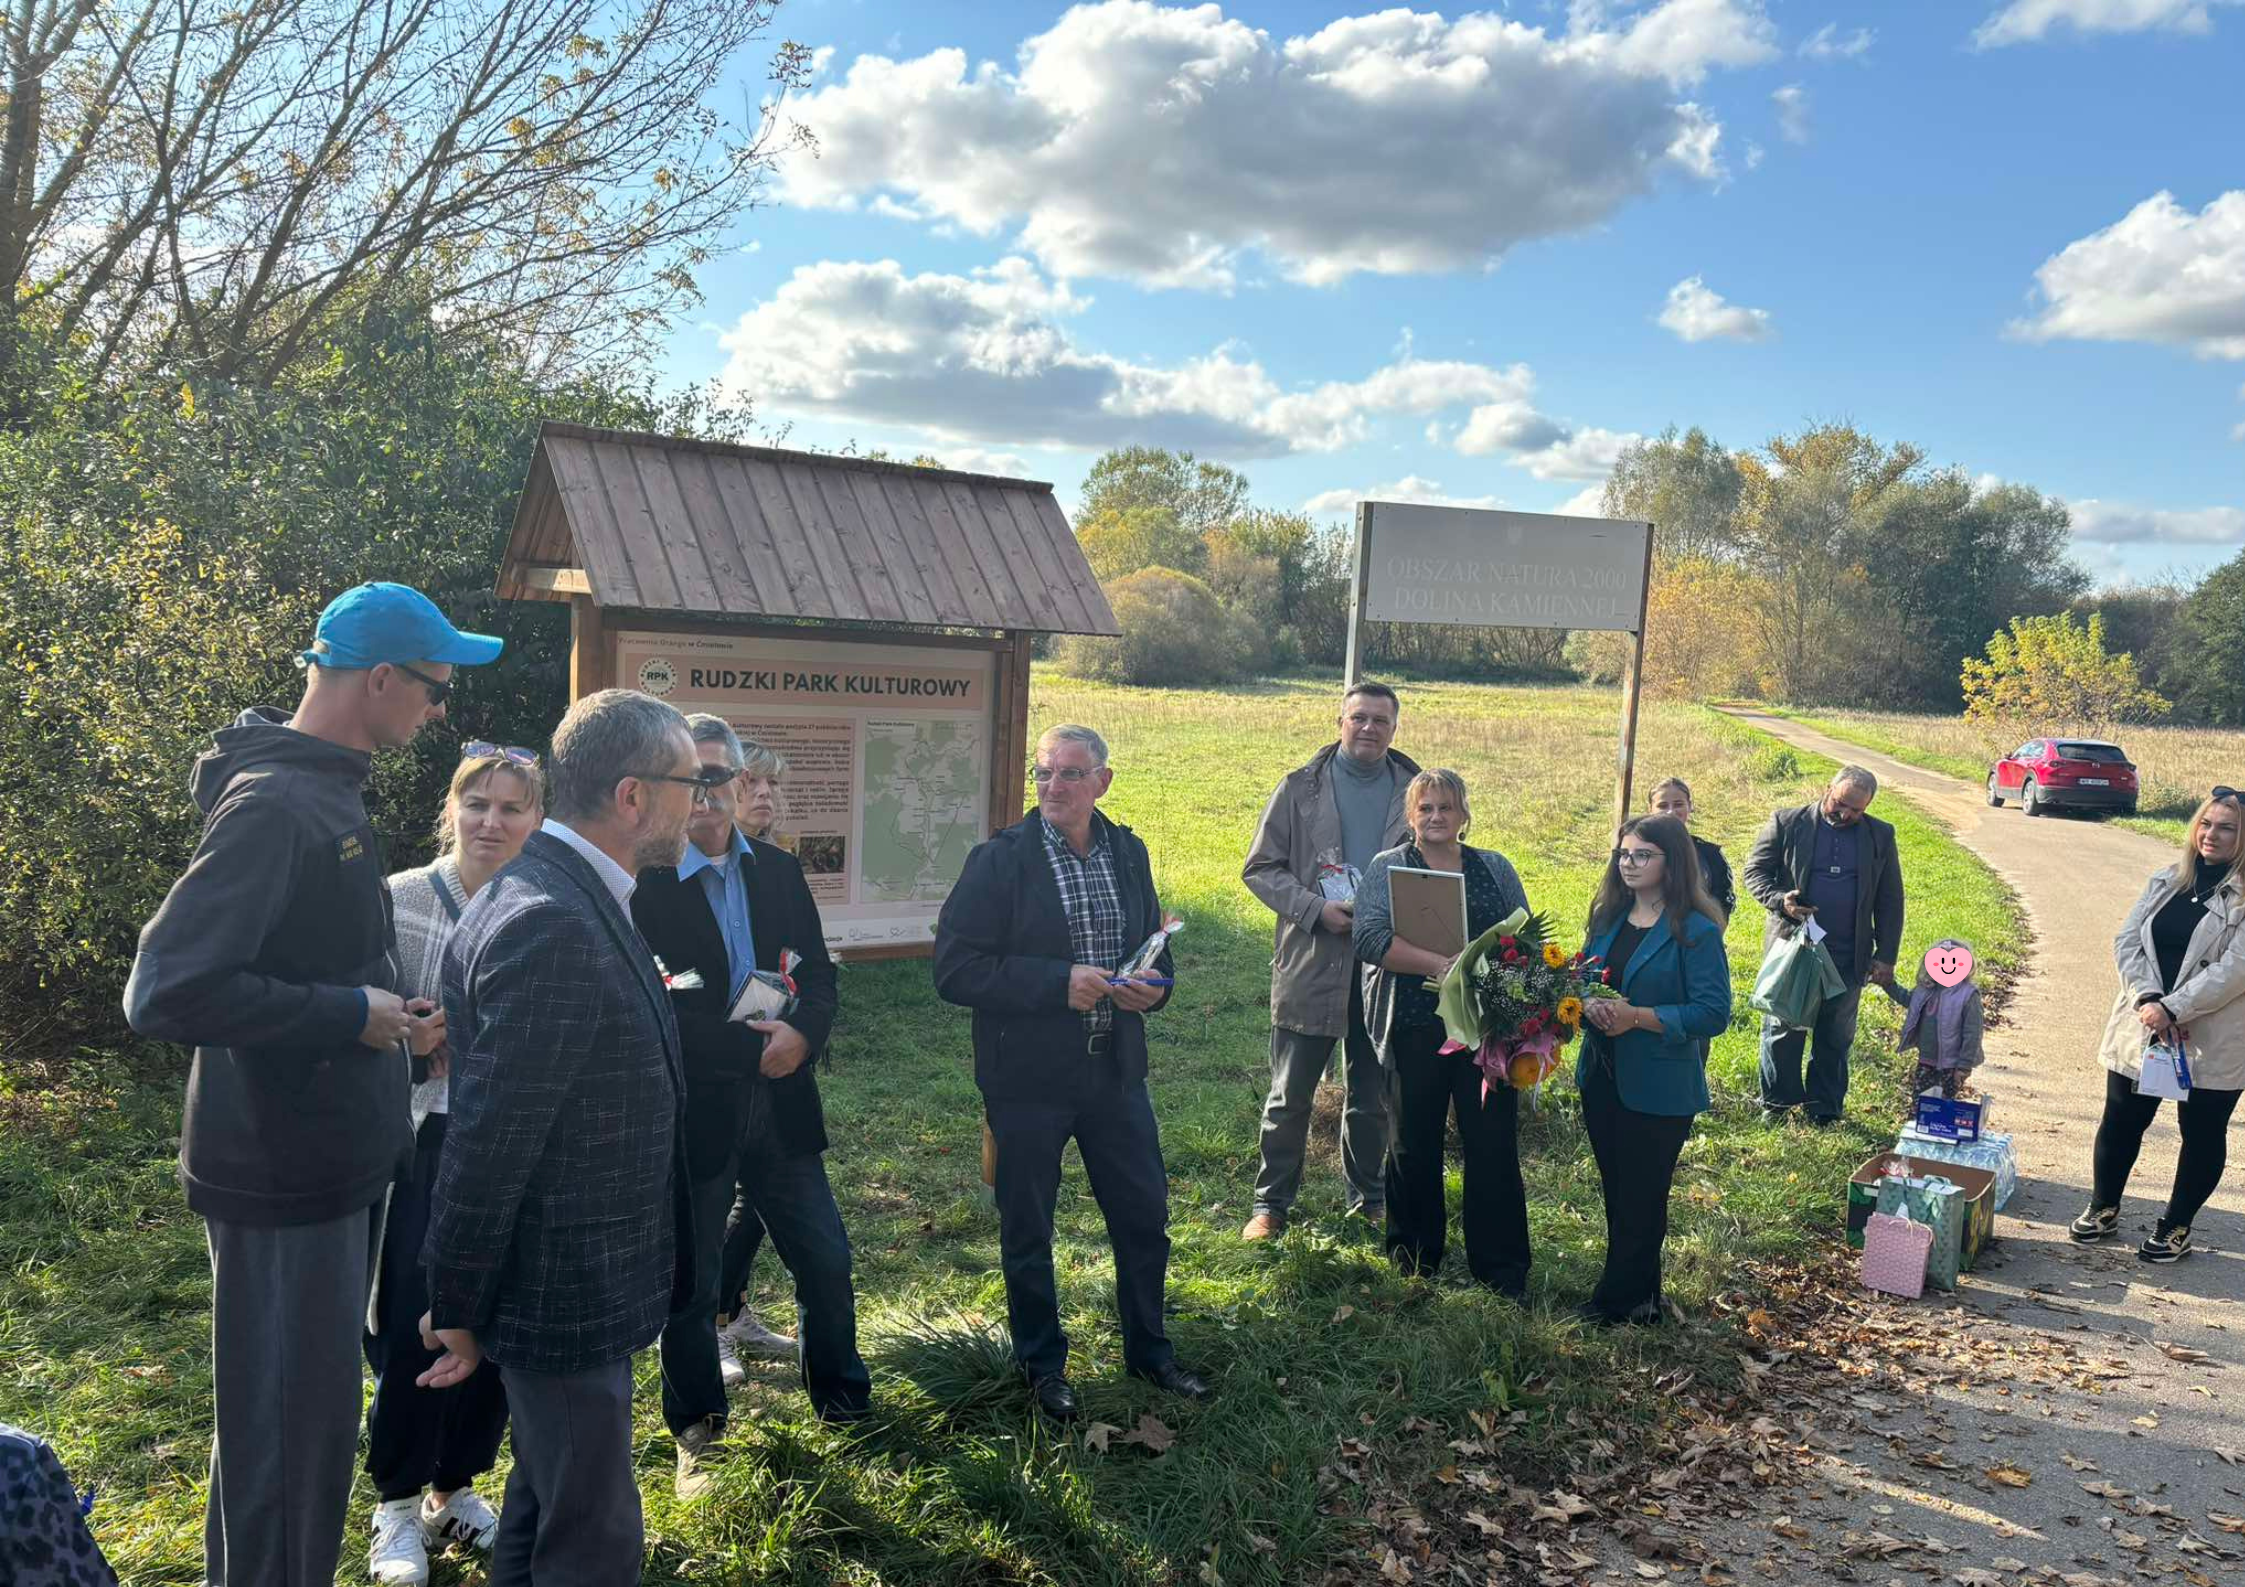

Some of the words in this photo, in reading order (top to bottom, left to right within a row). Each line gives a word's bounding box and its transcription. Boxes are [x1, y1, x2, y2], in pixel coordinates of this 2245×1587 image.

[1387, 556, 1482, 584] OBSZAR
[1488, 562, 1578, 589] NATURA
[1580, 567, 1627, 591] 2000
[1394, 587, 1484, 612] DOLINA
[1490, 591, 1617, 619] KAMIENNEJ
[646, 671, 669, 681] RPK
[690, 668, 776, 691] RUDZKI
[783, 672, 838, 693] PARK
[844, 675, 971, 697] KULTUROWY
